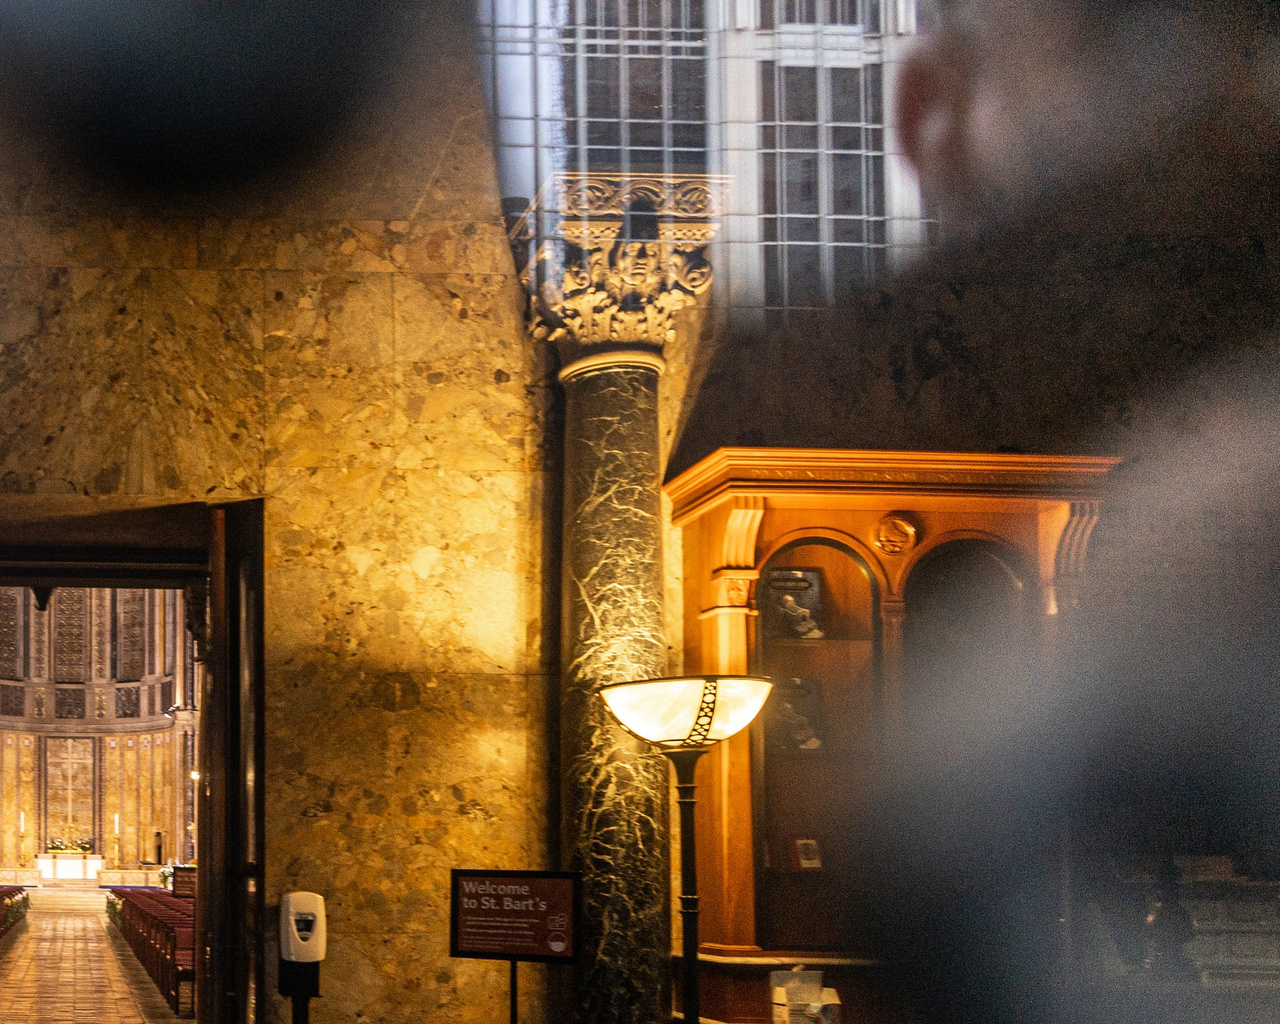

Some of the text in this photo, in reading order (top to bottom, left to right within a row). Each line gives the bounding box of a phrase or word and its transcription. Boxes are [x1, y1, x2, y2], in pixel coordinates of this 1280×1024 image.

[462, 880, 530, 895] Welcome
[463, 896, 547, 911] to St. Bart's
